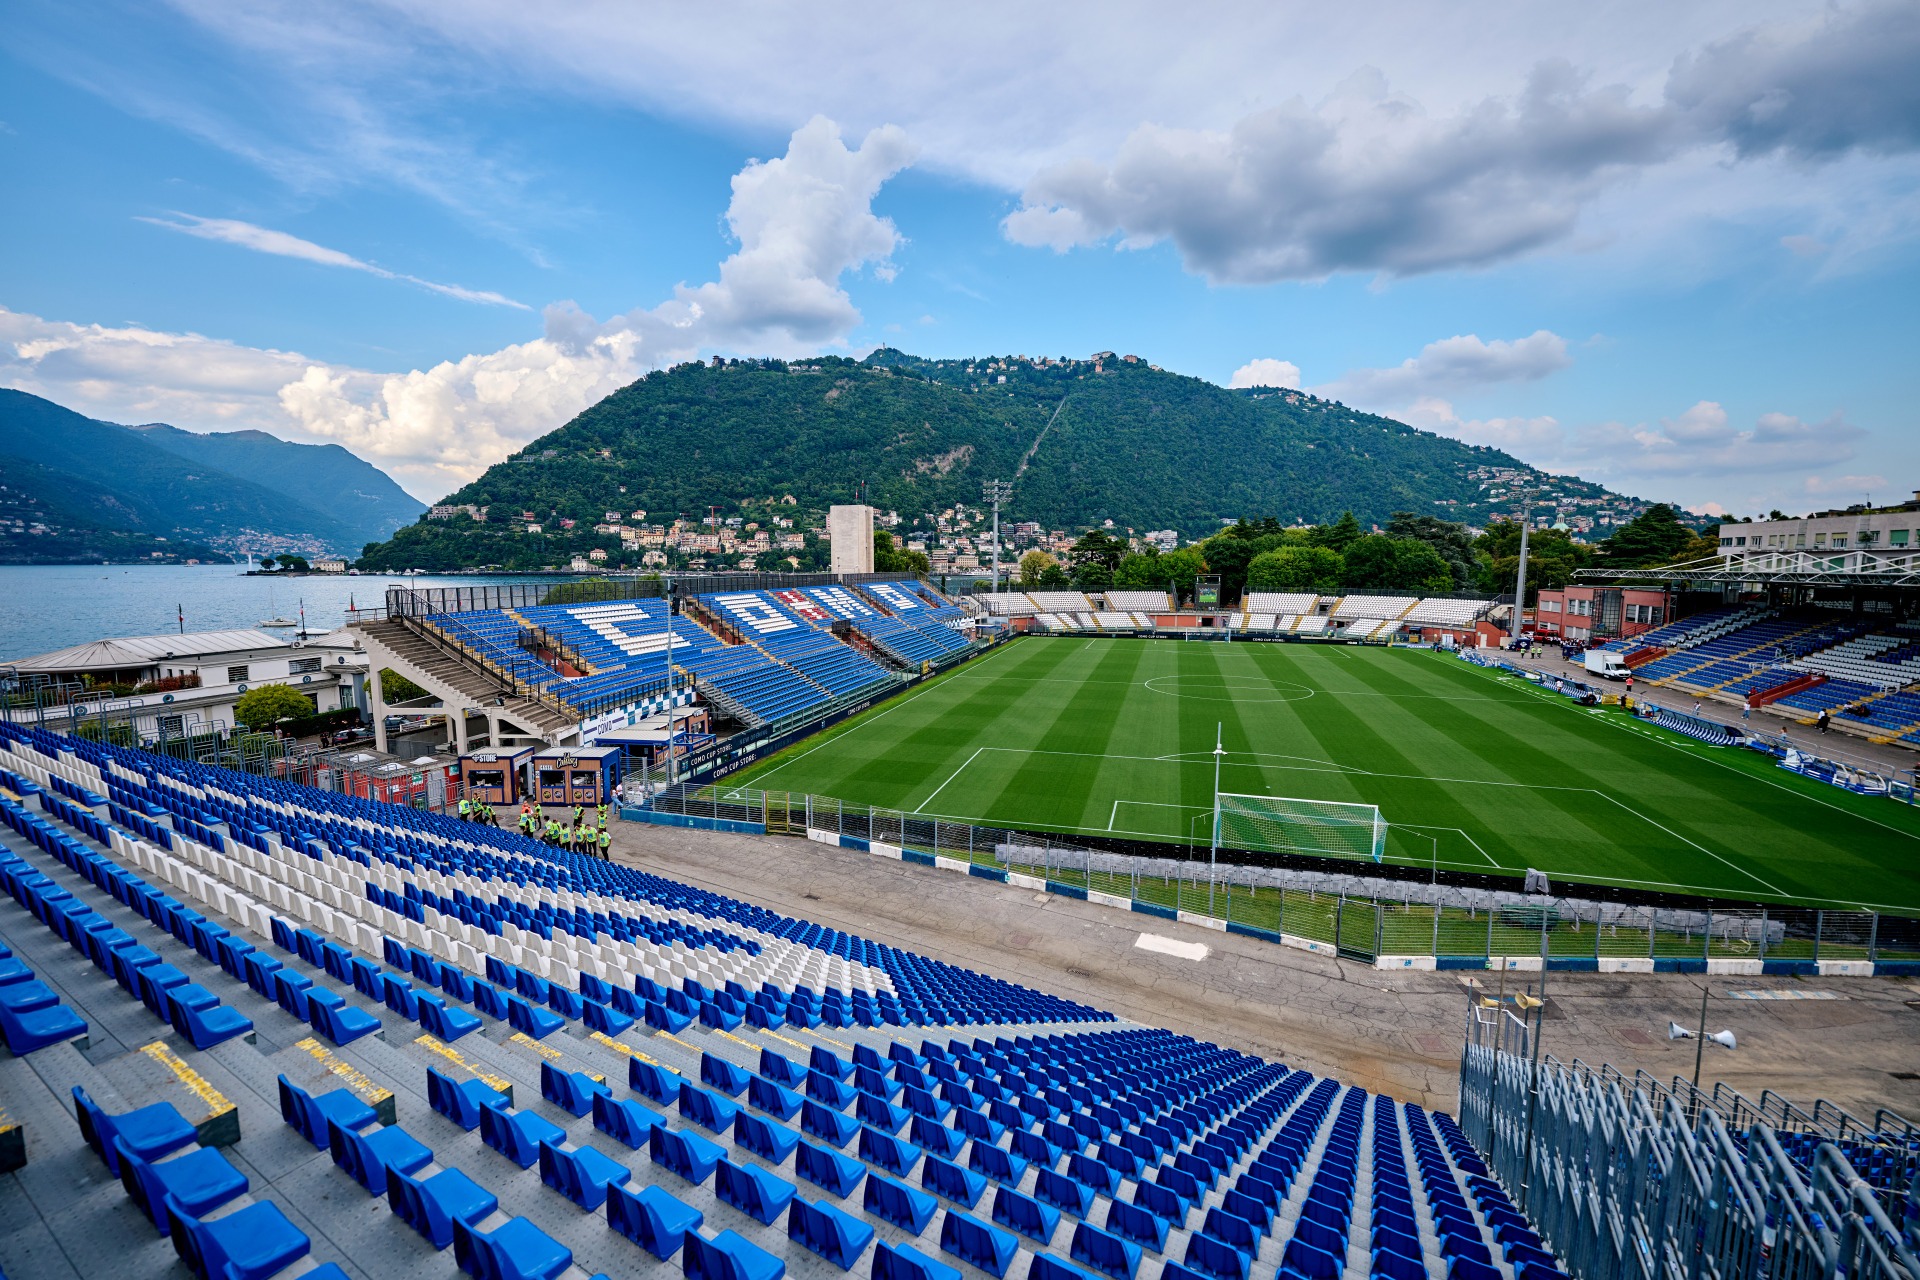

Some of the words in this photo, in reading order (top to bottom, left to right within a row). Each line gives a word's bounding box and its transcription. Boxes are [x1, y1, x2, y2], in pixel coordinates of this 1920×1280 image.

[598, 720, 612, 735] COMO
[479, 754, 497, 763] STORE
[690, 754, 706, 766] COMO
[706, 751, 716, 760] CUP
[716, 744, 733, 756] STORE:
[713, 767, 728, 778] COMO
[729, 763, 739, 774] CUP
[740, 754, 757, 767] STORE:
